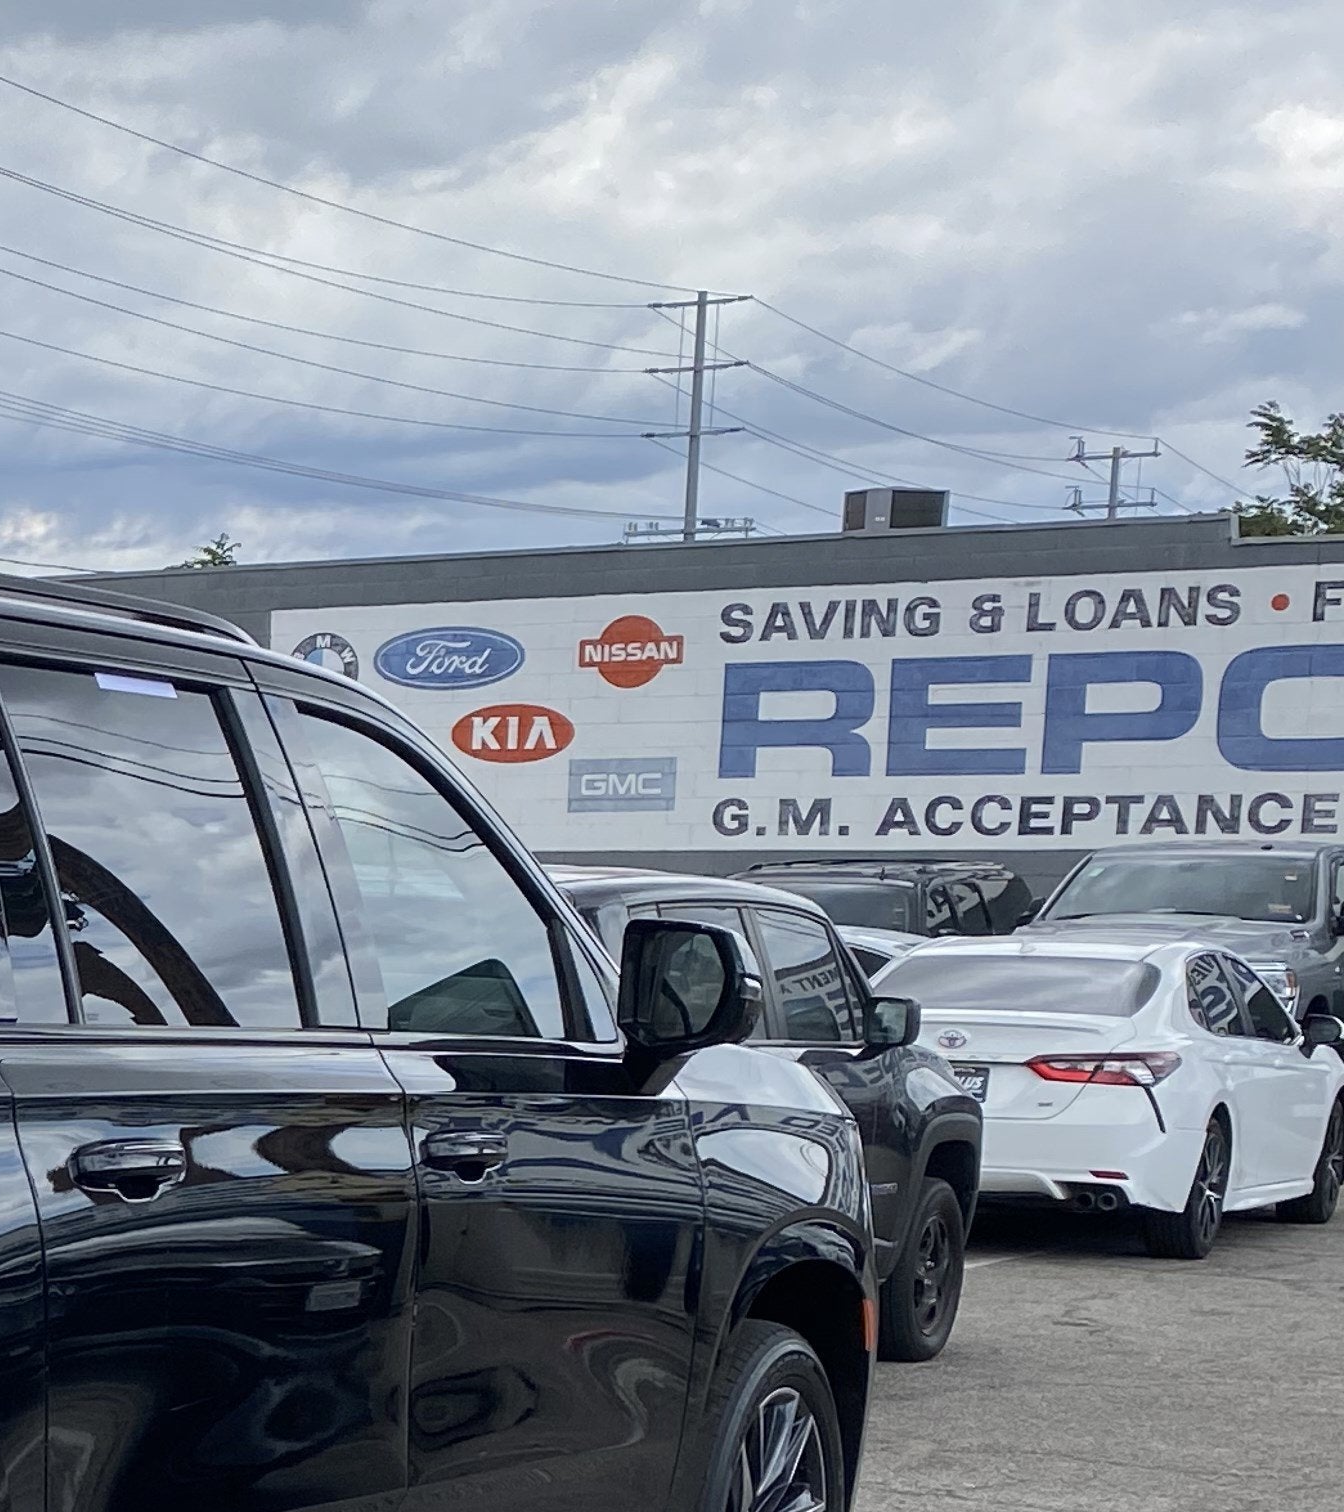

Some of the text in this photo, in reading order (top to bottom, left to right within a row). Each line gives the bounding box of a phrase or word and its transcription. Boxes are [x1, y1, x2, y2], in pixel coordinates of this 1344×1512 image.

[718, 596, 942, 645] SAVING
[968, 592, 1006, 634] &
[1025, 584, 1243, 632] LOANS
[405, 639, 493, 676] Ford
[583, 639, 679, 663] NISSAN
[470, 715, 558, 751] KIA
[580, 771, 663, 796] GMC
[711, 791, 1341, 837] G.M. ACCEPTANCE
